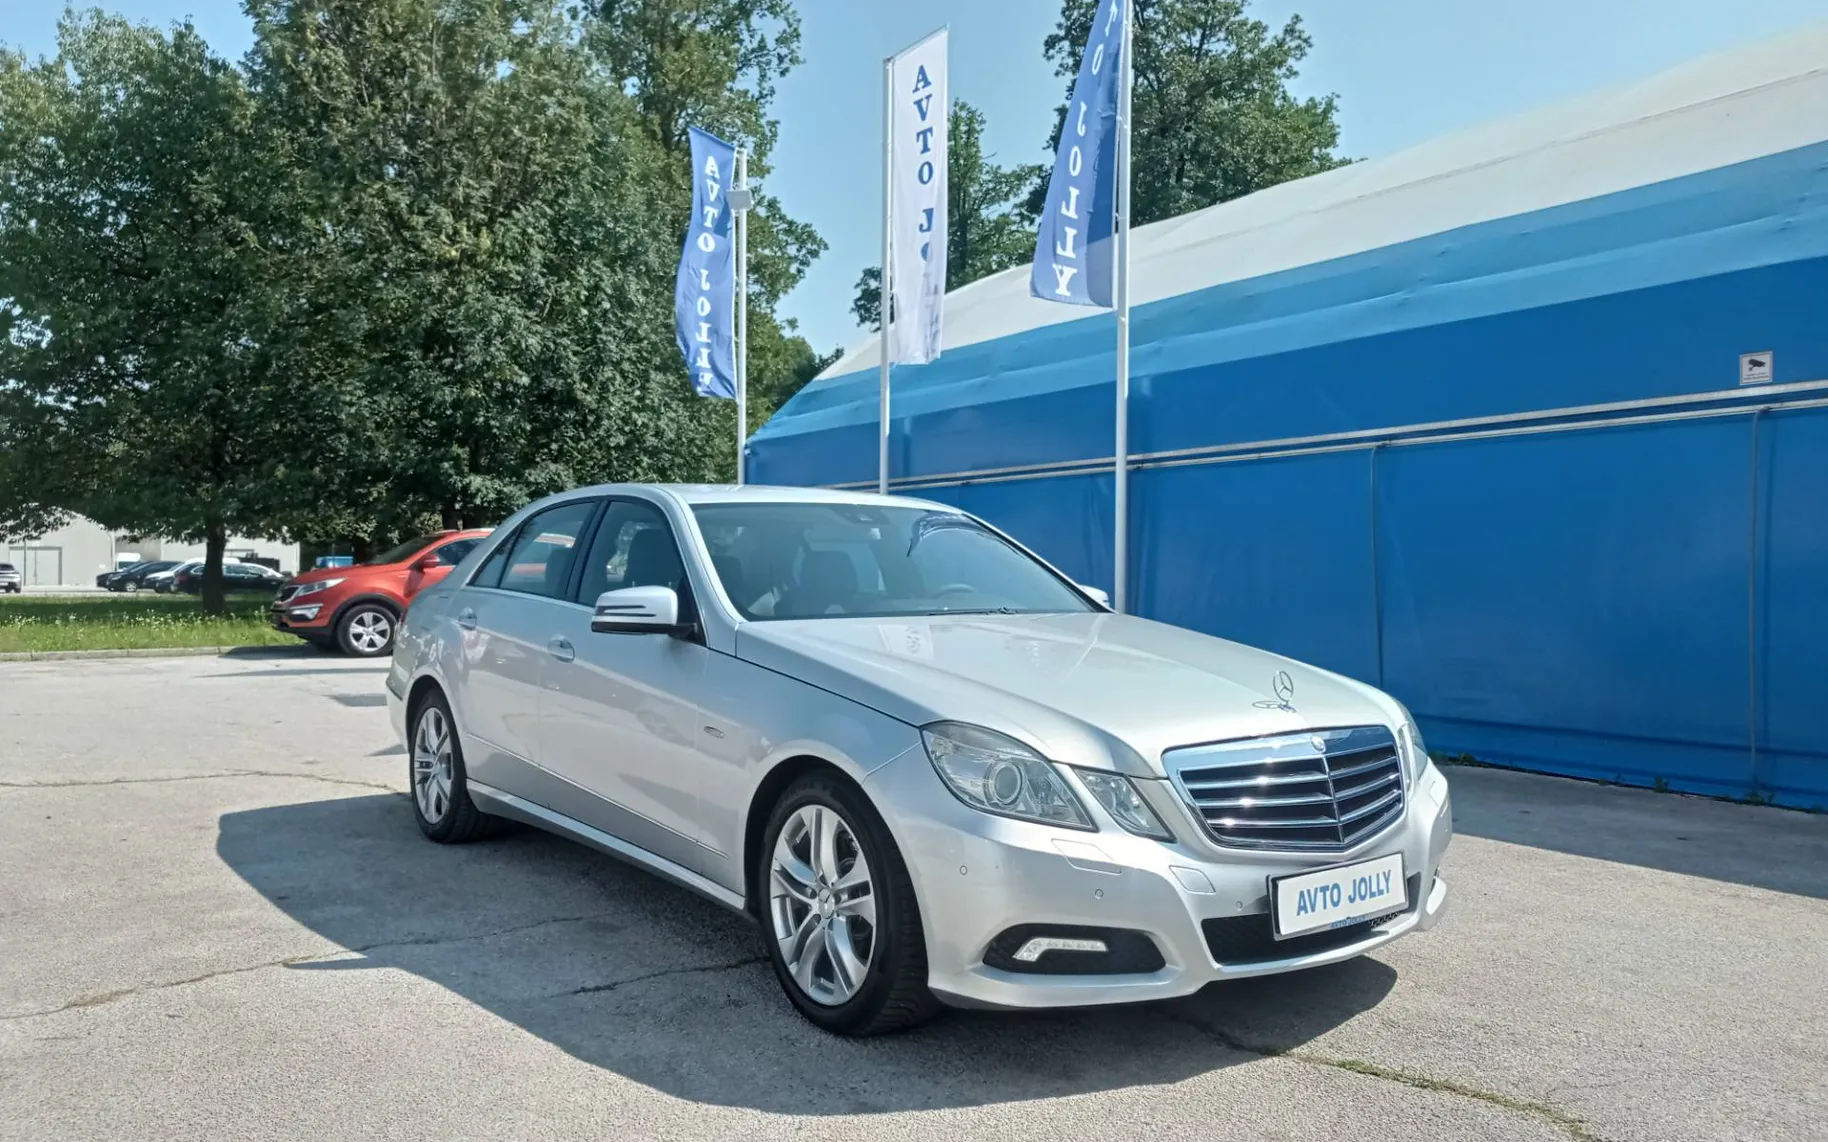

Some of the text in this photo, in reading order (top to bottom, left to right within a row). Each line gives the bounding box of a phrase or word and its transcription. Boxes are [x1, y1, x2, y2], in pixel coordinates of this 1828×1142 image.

[912, 64, 934, 185] AVTO
[1296, 869, 1391, 916] AVTO JOLLY
